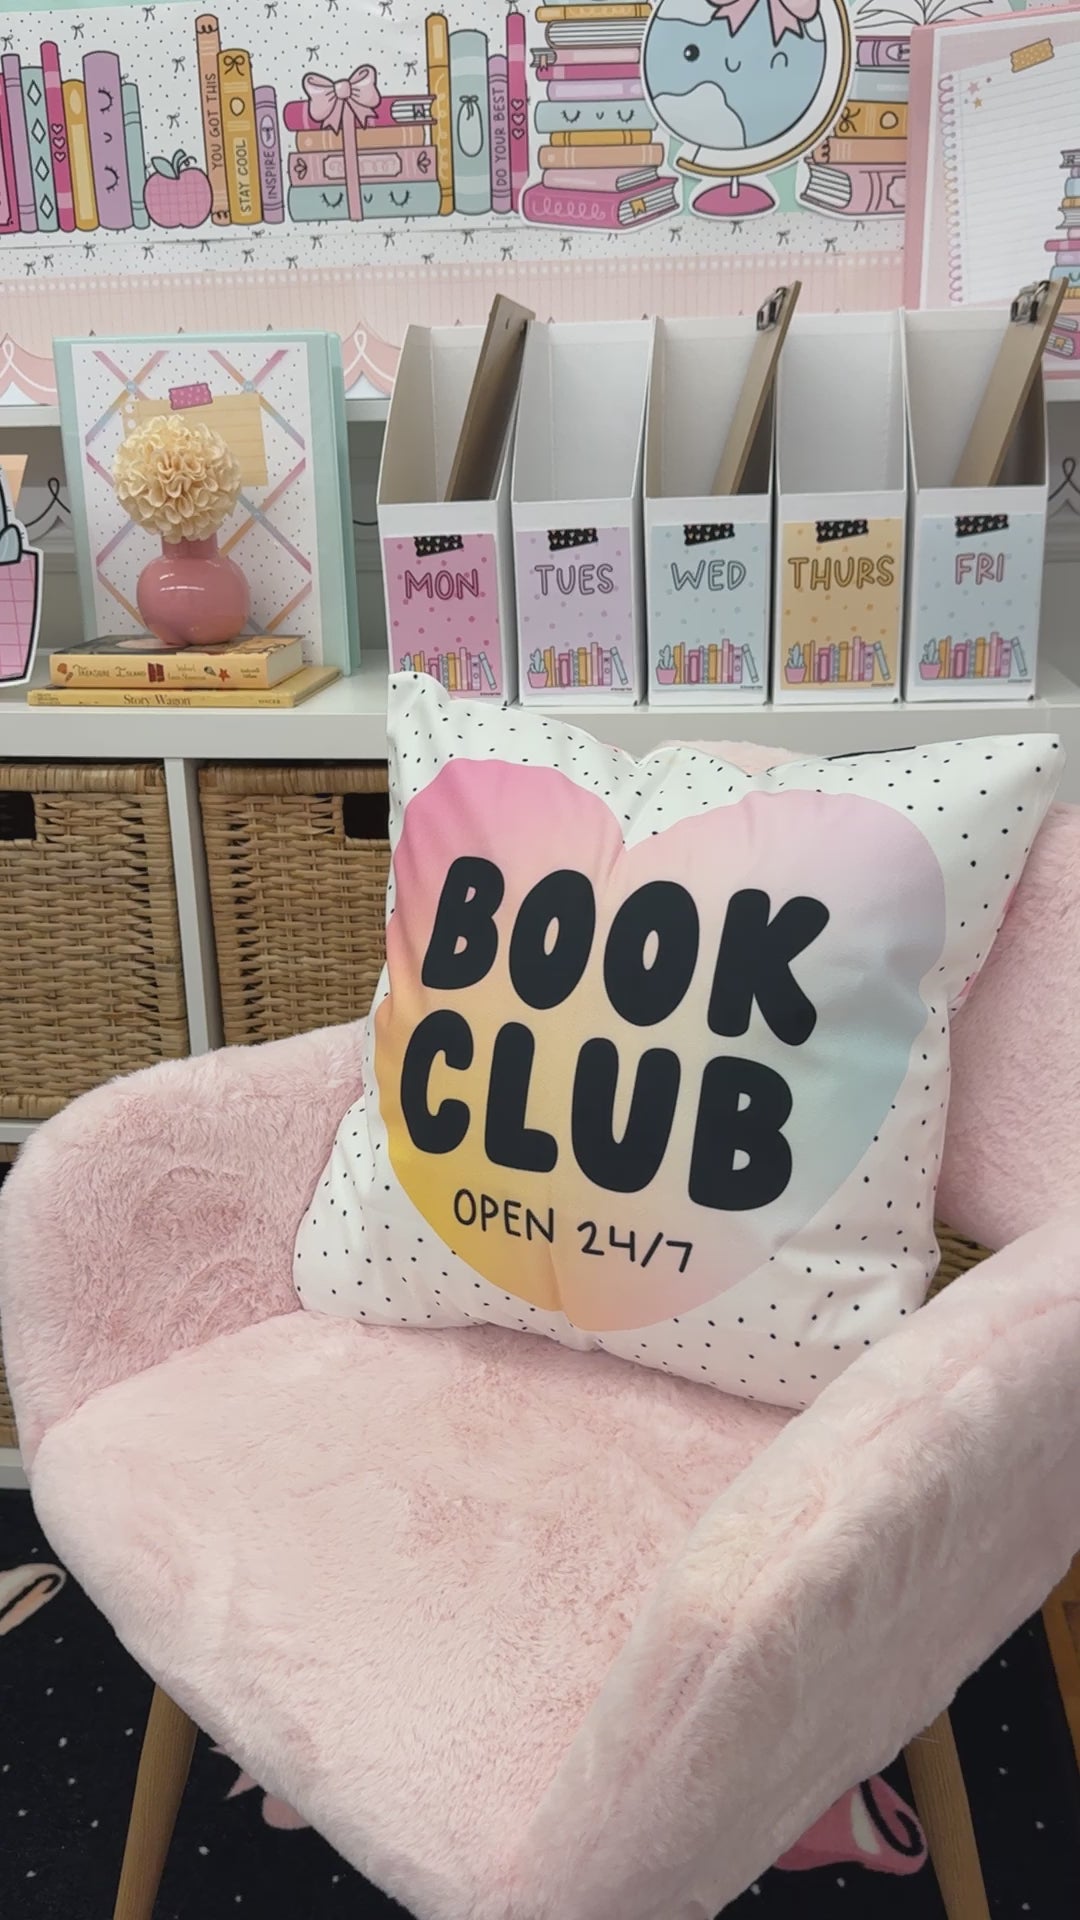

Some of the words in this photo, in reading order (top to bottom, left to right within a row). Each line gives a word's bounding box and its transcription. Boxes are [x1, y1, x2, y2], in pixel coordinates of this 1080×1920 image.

[205, 73, 218, 103] THIS
[492, 88, 506, 122] BEST
[208, 111, 220, 138] GOT
[211, 145, 223, 170] YOU
[235, 139, 249, 176] COOL
[494, 128, 507, 163] YOUR
[263, 151, 278, 200] INSPIRE
[495, 169, 507, 186] DO
[238, 182, 252, 213] STAY
[404, 568, 480, 600] MON
[534, 563, 615, 596] TUES
[671, 559, 747, 592] WED
[788, 555, 895, 591] THURS
[955, 553, 1005, 585] FRI
[123, 694, 150, 706] Story
[154, 694, 191, 707] Wagon
[421, 856, 830, 1046] BOOK
[400, 1009, 794, 1211] CLUB
[453, 1188, 555, 1244] OPEN
[577, 1221, 694, 1273] 24/7
